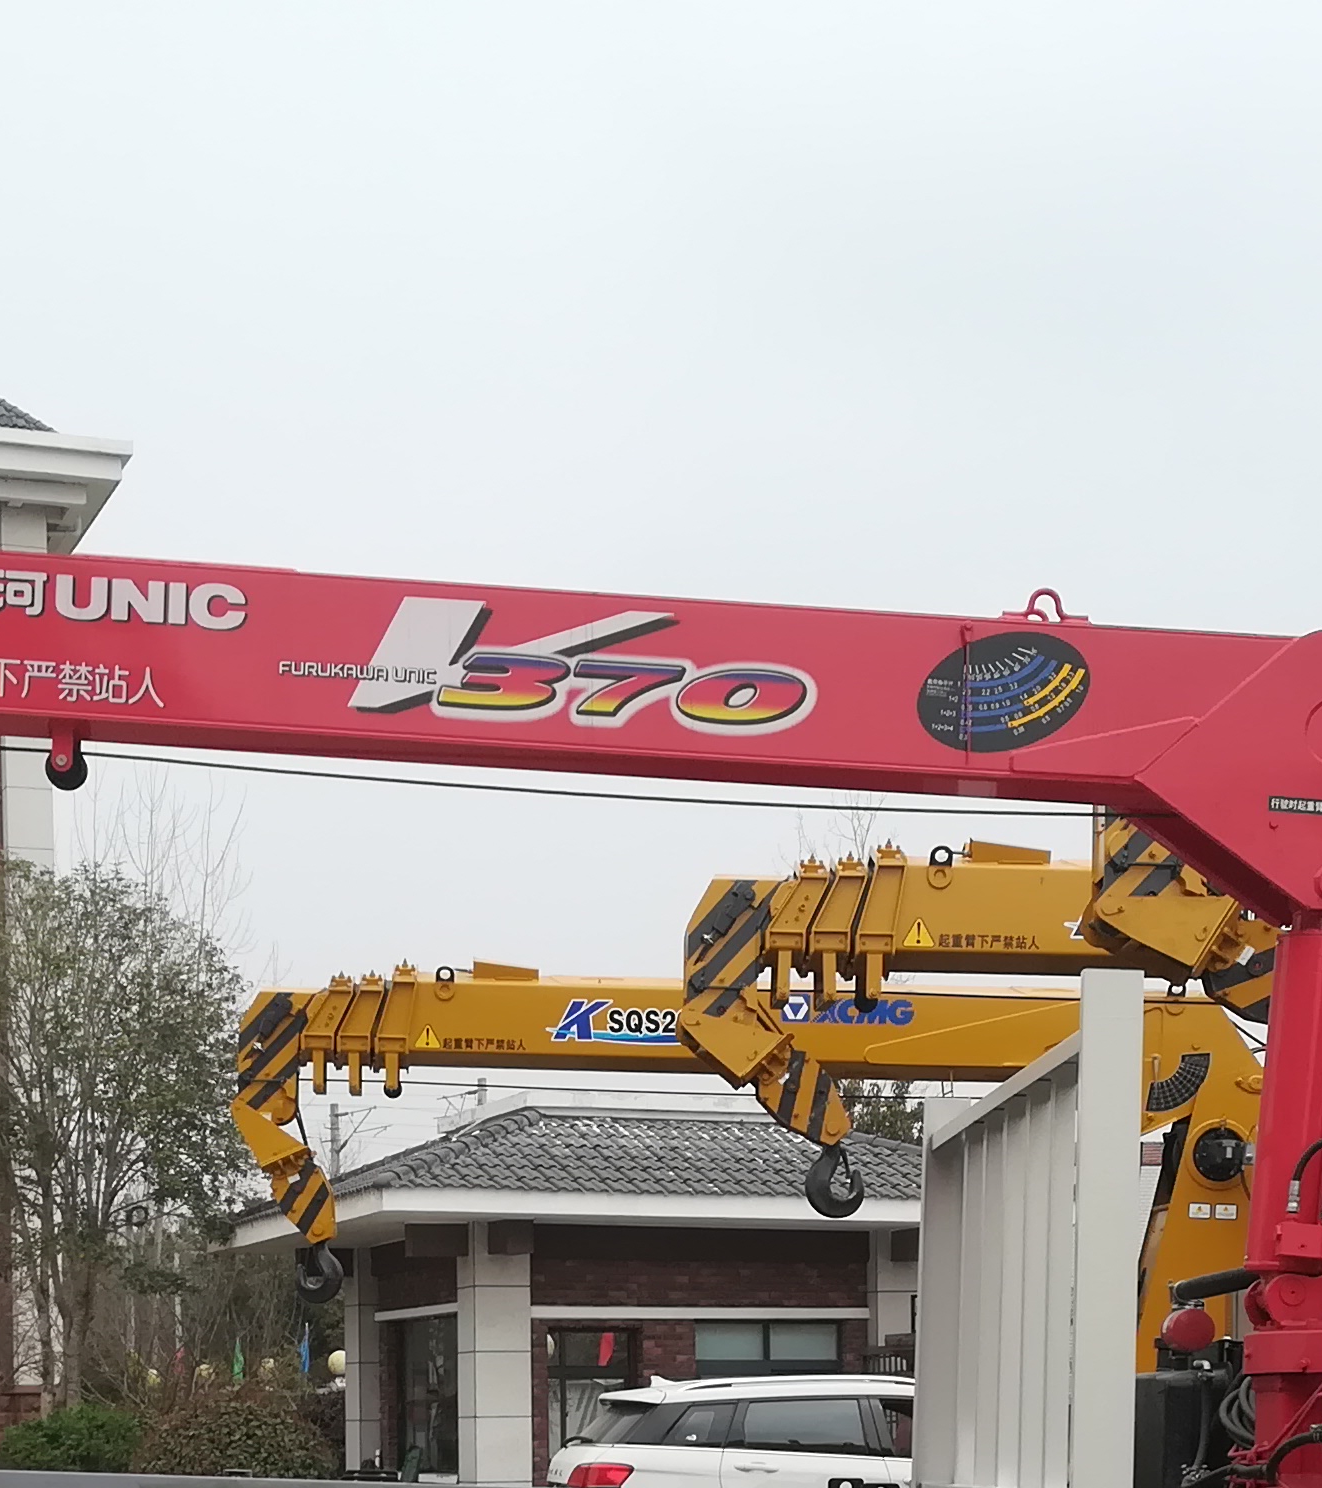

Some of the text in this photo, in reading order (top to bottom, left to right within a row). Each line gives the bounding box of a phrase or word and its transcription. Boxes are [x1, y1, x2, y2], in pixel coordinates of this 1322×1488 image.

[278, 660, 437, 684] FURUKAWA UNIC
[938, 933, 1040, 950] 起重臂下严禁站人
[551, 999, 680, 1041] K SQS2
[442, 1037, 526, 1051] 起重臂下严禁站人
